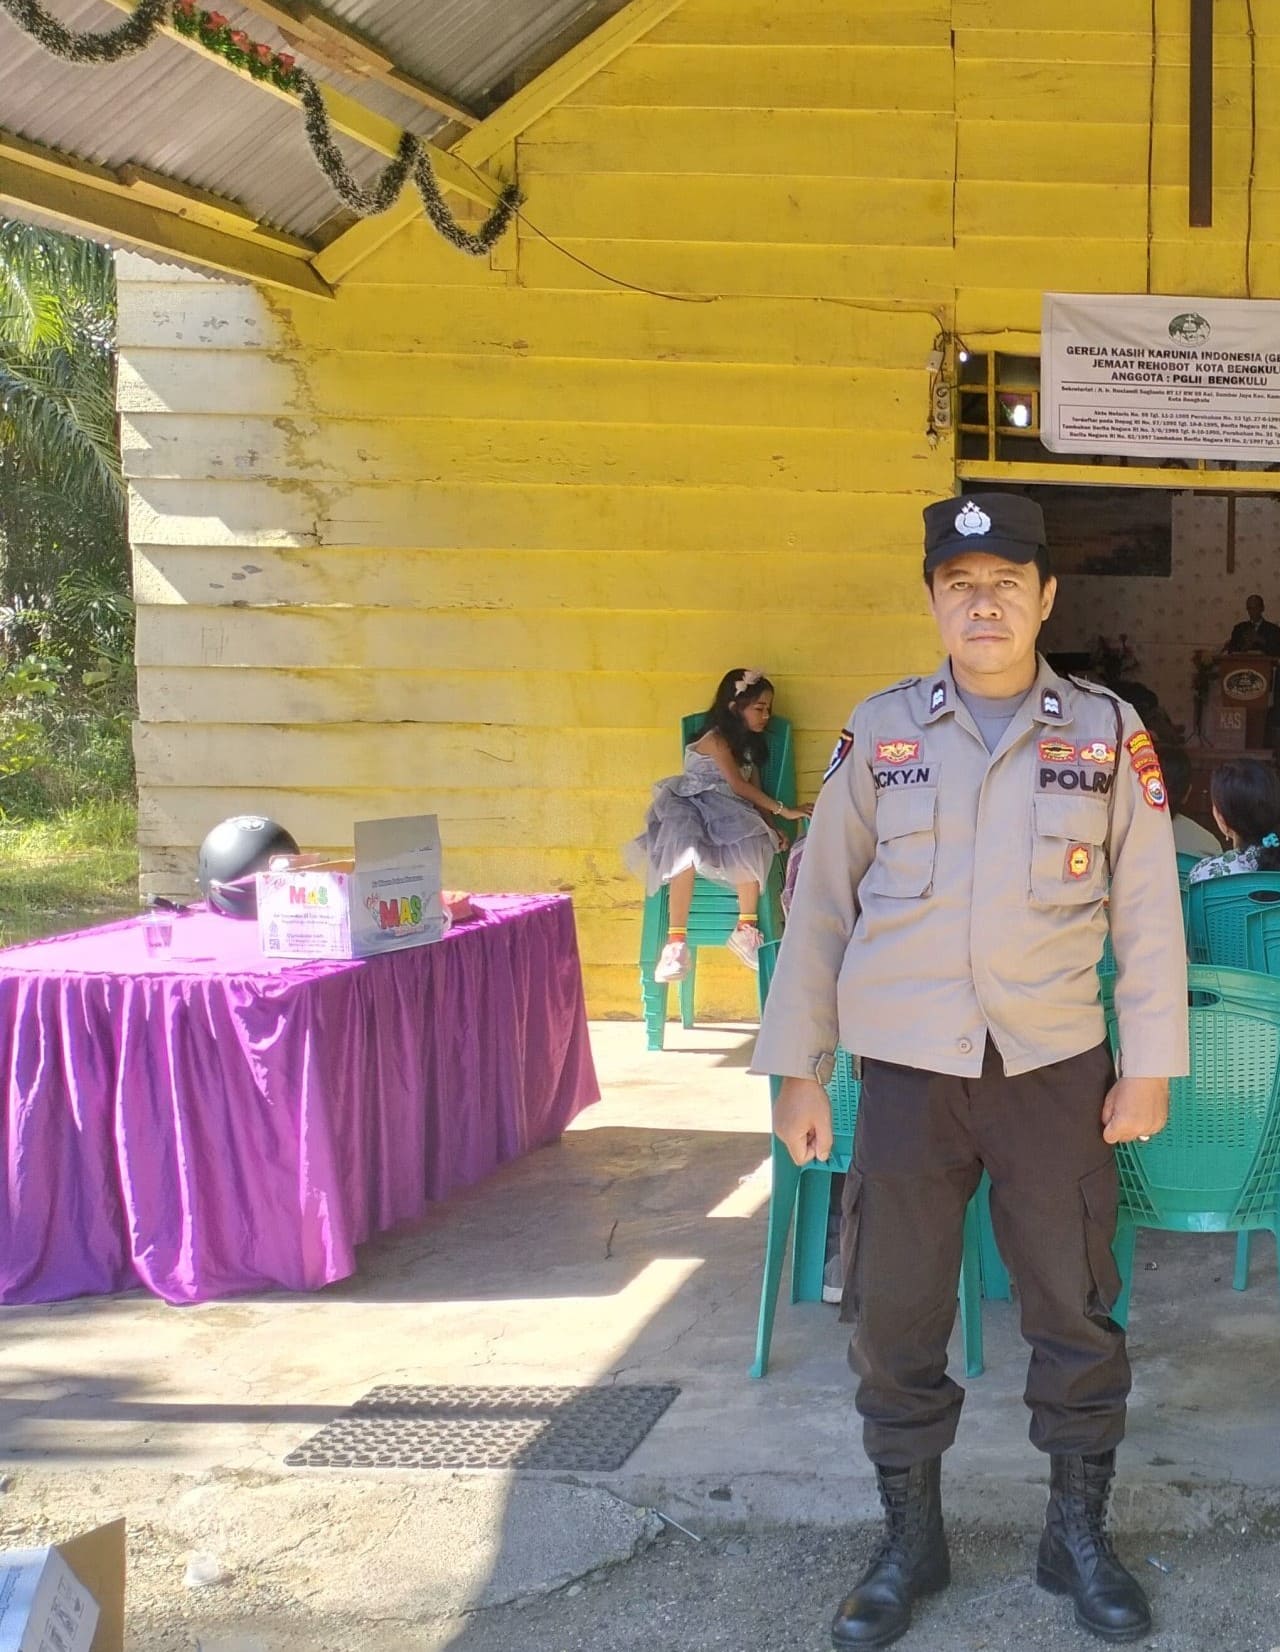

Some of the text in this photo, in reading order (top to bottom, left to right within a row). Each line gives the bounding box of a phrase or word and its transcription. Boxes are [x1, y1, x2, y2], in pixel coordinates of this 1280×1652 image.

[1066, 346, 1108, 357] GEREJA
[1111, 348, 1145, 358] KASIH
[1148, 349, 1198, 360] KARUNIA
[1201, 351, 1262, 363] INDONESIA
[1092, 359, 1135, 369] JEMAAT
[1137, 361, 1190, 372] REHOBOT
[1196, 363, 1224, 373] KOTA
[1111, 372, 1164, 383] ANGGOTA
[1172, 374, 1202, 384] PGLII
[1208, 376, 1268, 386] BENGKULU
[289, 885, 329, 906] MAS
[379, 894, 423, 930] MAS
